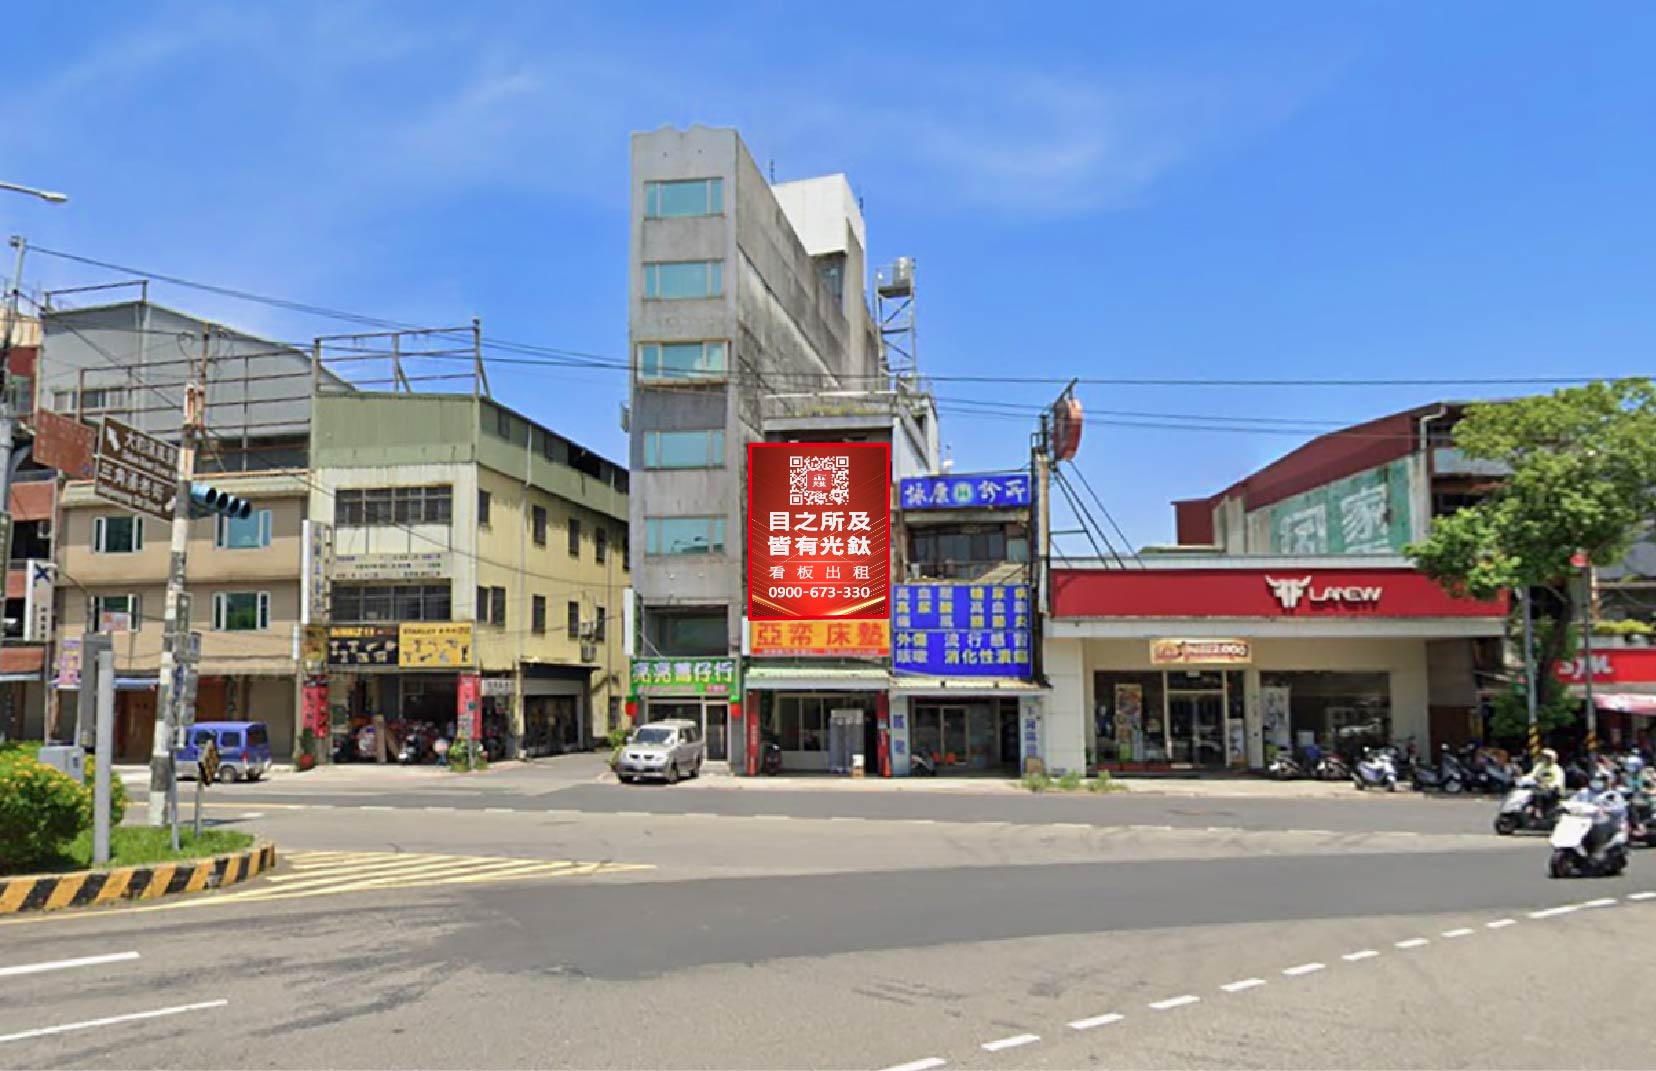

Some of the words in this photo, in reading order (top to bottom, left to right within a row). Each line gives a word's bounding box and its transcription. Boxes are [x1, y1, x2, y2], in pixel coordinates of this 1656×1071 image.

[769, 511, 871, 532] 目之所及
[768, 535, 871, 556] 皆有光鈦
[769, 565, 870, 580] 看板出租
[768, 586, 871, 599] 0900-673-330
